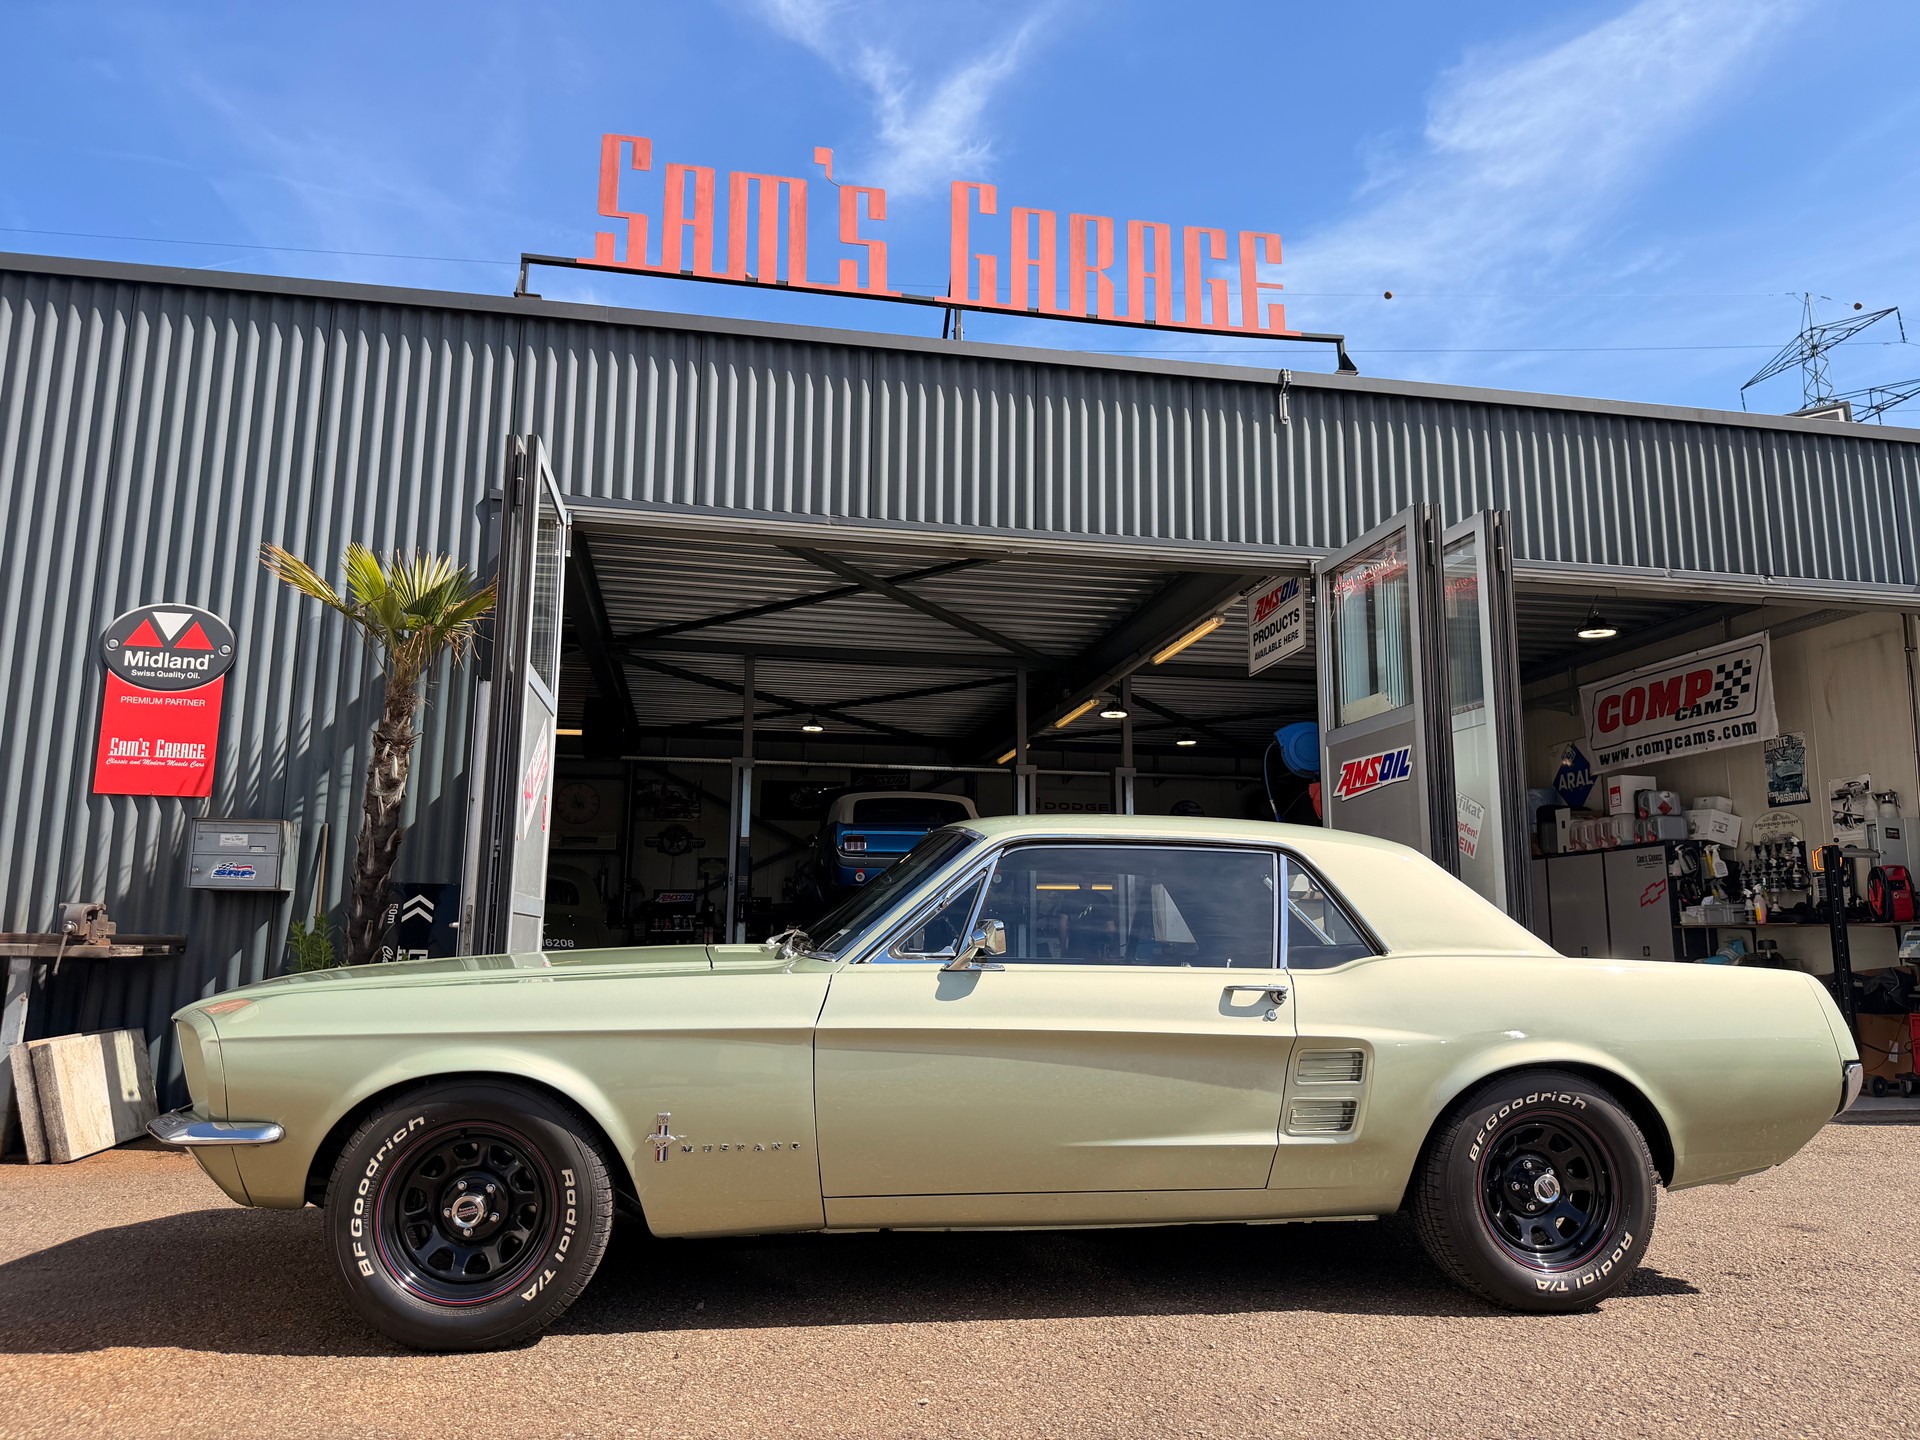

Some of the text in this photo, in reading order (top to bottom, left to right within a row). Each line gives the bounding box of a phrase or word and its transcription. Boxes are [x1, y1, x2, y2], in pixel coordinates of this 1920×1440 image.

[1253, 577, 1300, 622] AMSOIL
[1253, 608, 1300, 646] PRODUCTS
[1254, 629, 1299, 661] AVAILABLE HERE
[131, 669, 201, 680] Swiss Quality Oil.
[120, 695, 206, 707] PREMIUM PARTNER
[1598, 669, 1713, 733] COMP
[1674, 695, 1739, 721] CAMS
[1599, 721, 1757, 766] www.compcams.com
[105, 757, 128, 765] Classic
[166, 760, 189, 768] Muscle
[189, 760, 205, 769] Cars
[1336, 748, 1411, 800] AMSOIL
[1559, 769, 1594, 791] ARAL
[1044, 801, 1109, 812] DODGE
[1775, 790, 1809, 804] PASSION!
[1468, 1091, 1587, 1162] BFGoodrich
[351, 1115, 425, 1277] BFGoodrich
[521, 1168, 578, 1301] Radial T/A
[1535, 1231, 1634, 1293] Radial T/A
